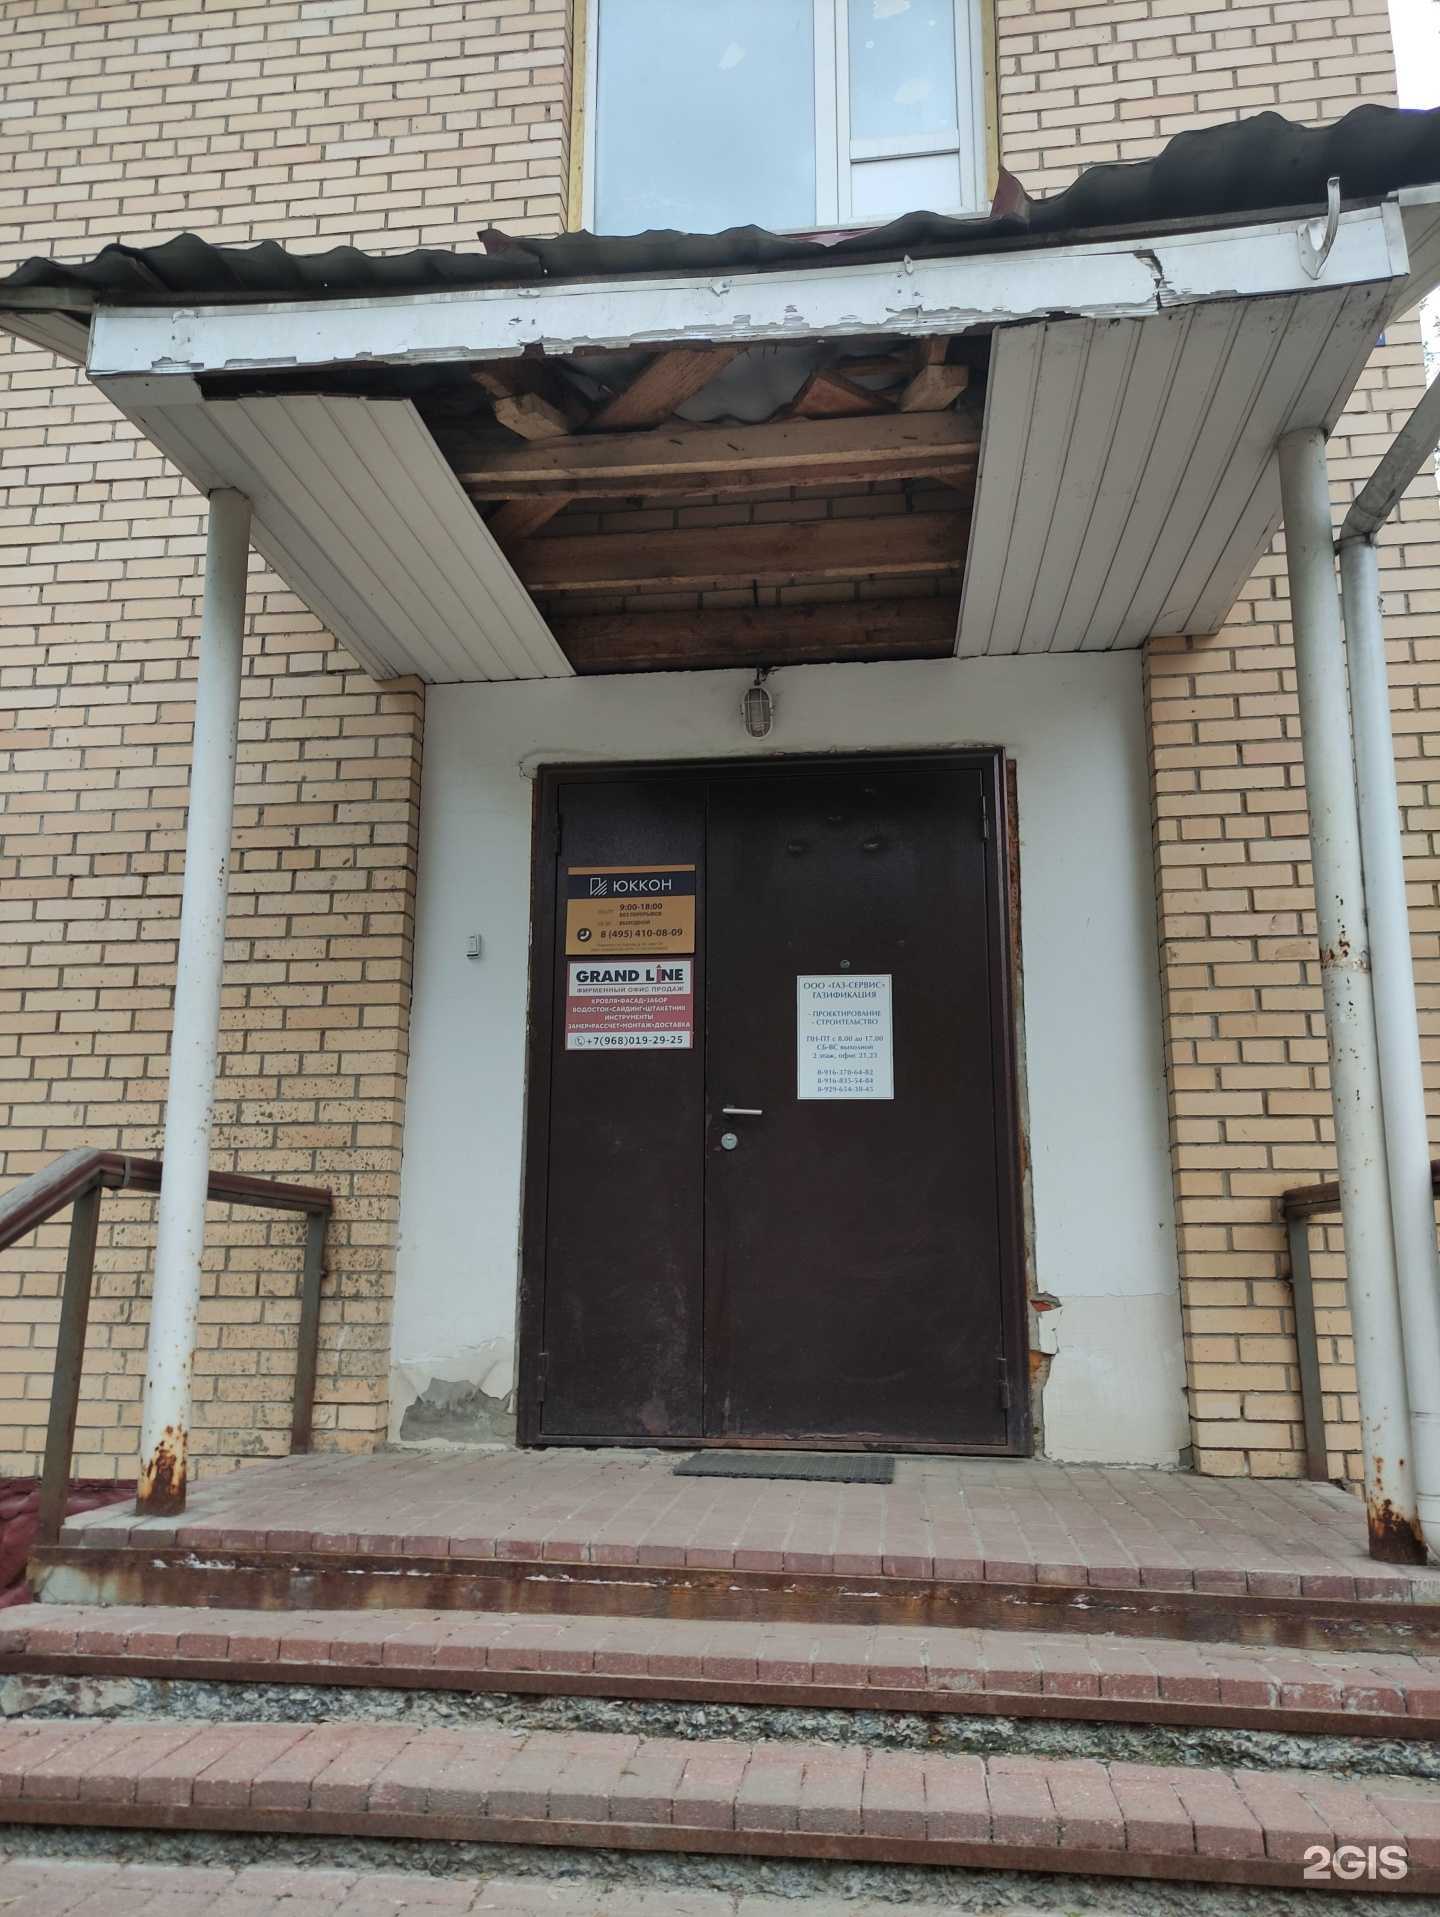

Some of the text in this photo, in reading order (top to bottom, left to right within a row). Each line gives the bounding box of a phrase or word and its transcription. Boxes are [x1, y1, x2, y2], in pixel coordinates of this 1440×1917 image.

[613, 879, 672, 893] ЮККОН
[619, 903, 663, 911] 9:00-18:00
[608, 930, 633, 939] (495)
[634, 928, 683, 938] 410-08-09
[576, 969, 640, 983] GRAND
[651, 985, 684, 993] ПРОДАЖ
[803, 982, 826, 990] ООО
[812, 991, 877, 999] ГАЗИФИКАЦИЯ
[812, 1010, 882, 1018] ПРОЕКТИРОВАНИЕ
[587, 1035, 684, 1046] +7(968)019-29-25
